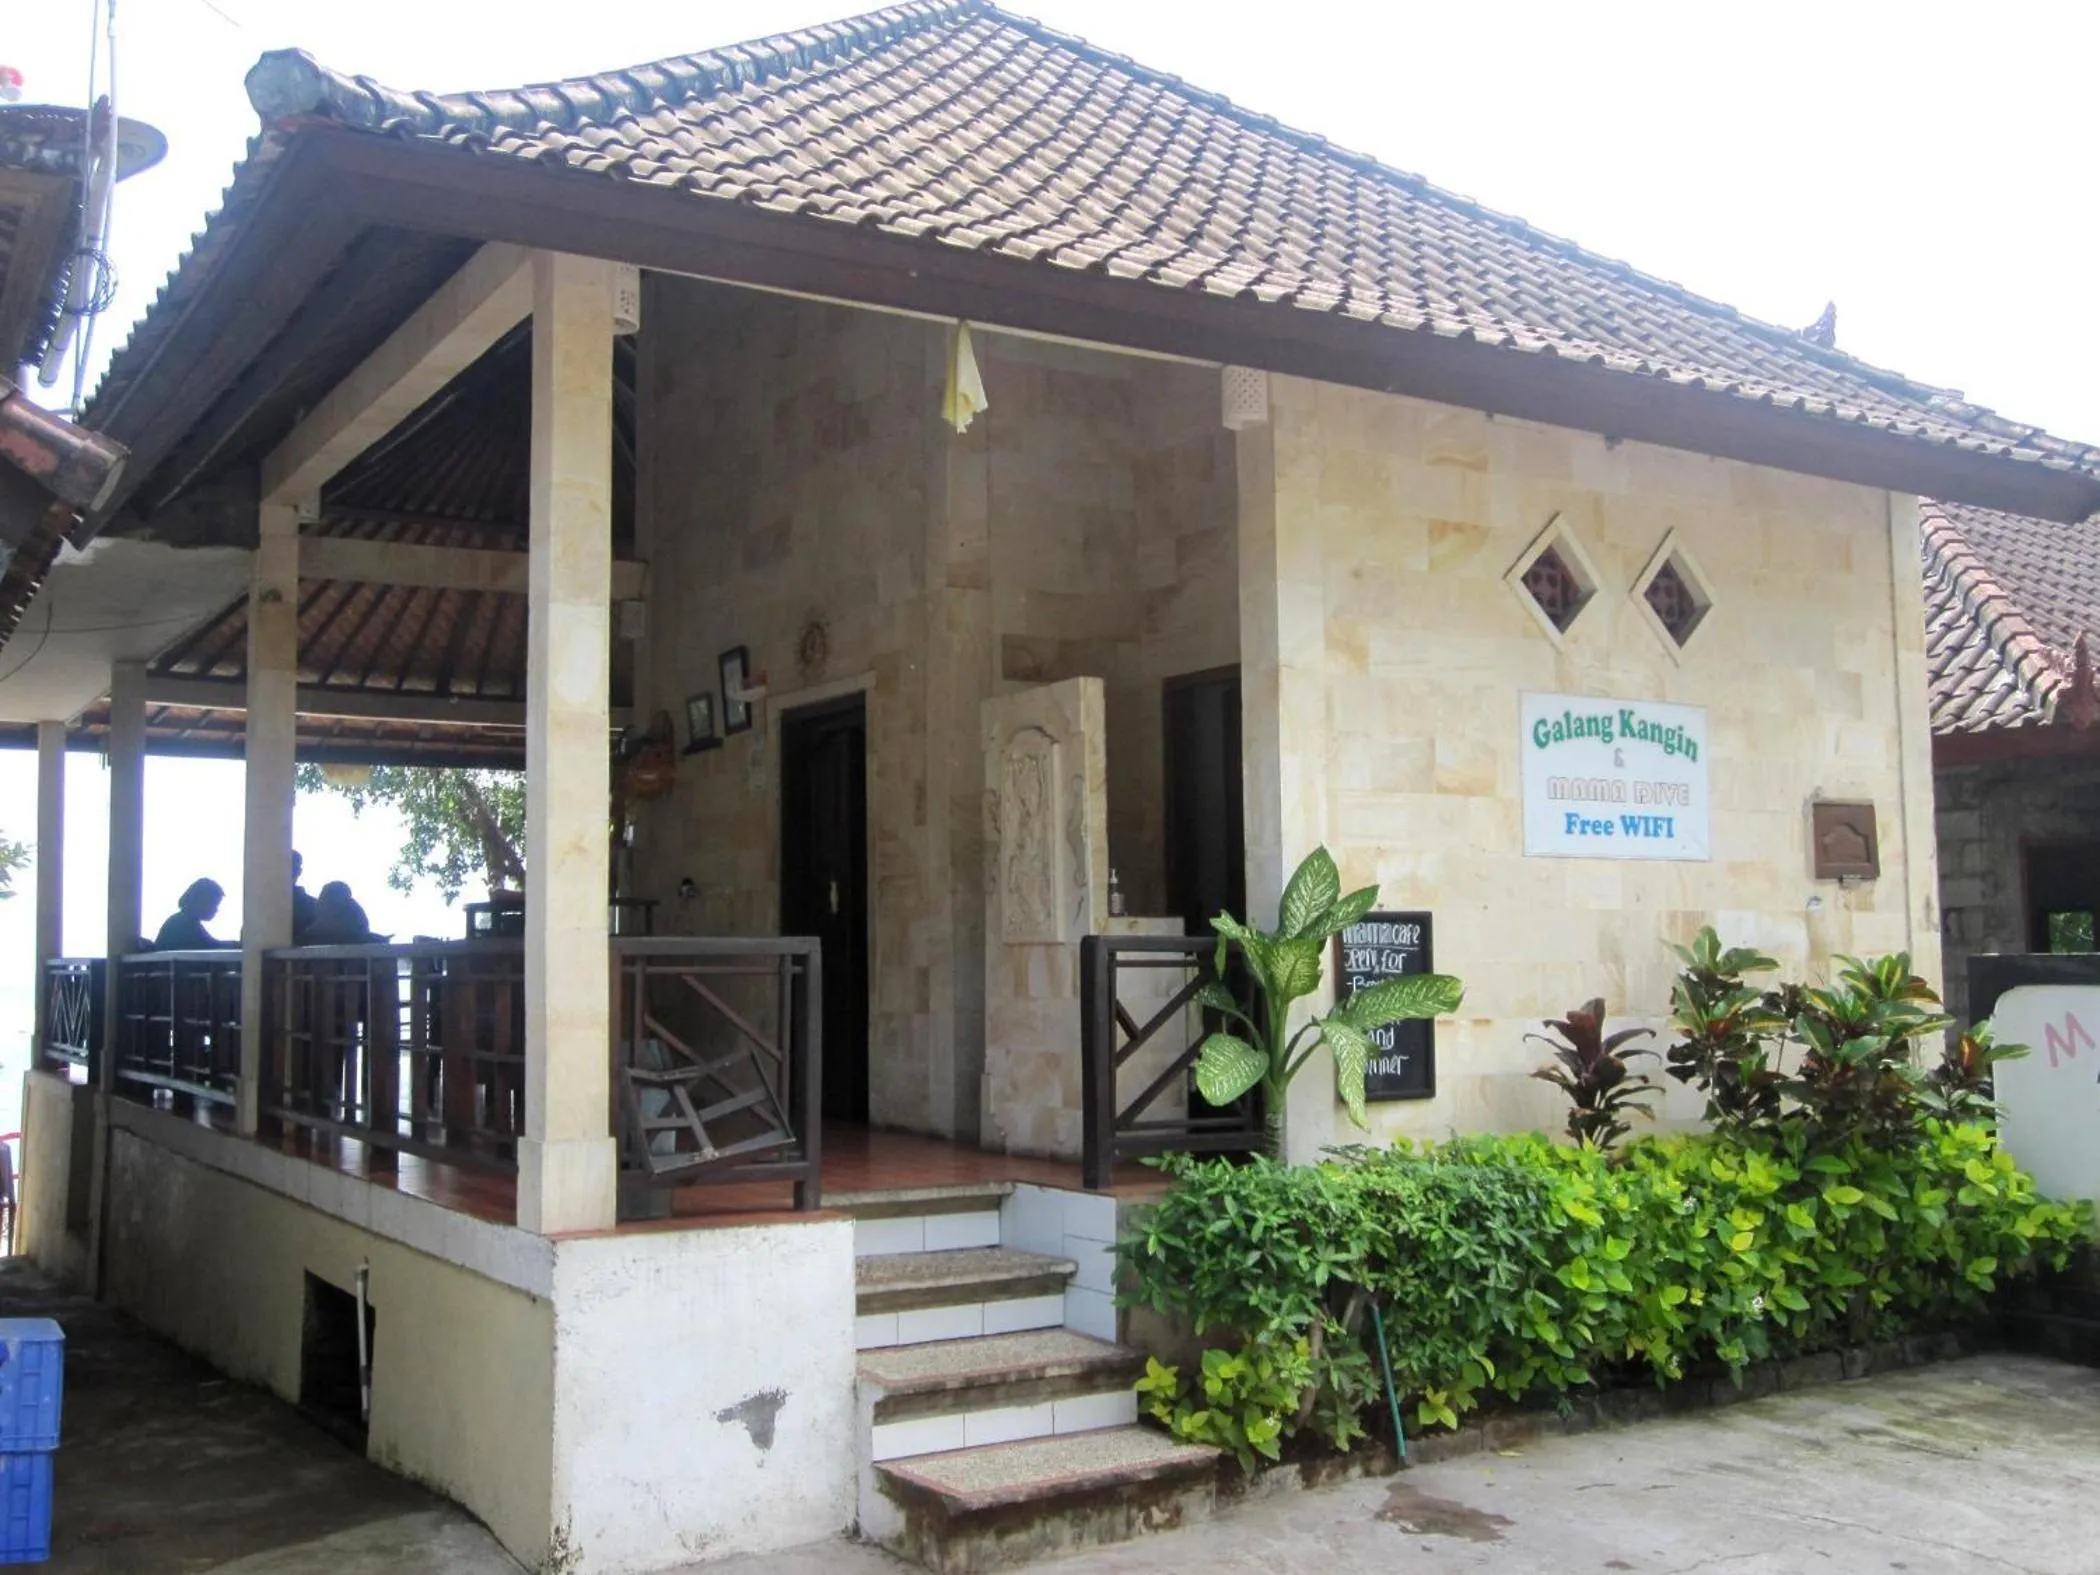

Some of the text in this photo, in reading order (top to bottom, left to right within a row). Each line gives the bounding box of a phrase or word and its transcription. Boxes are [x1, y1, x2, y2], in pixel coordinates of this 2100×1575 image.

[1533, 708, 1698, 762] Galang Kangin
[1547, 777, 1690, 806] MAMA DIVE
[1565, 812, 1675, 838] Free WIFI
[1363, 1054, 1409, 1075] inner
